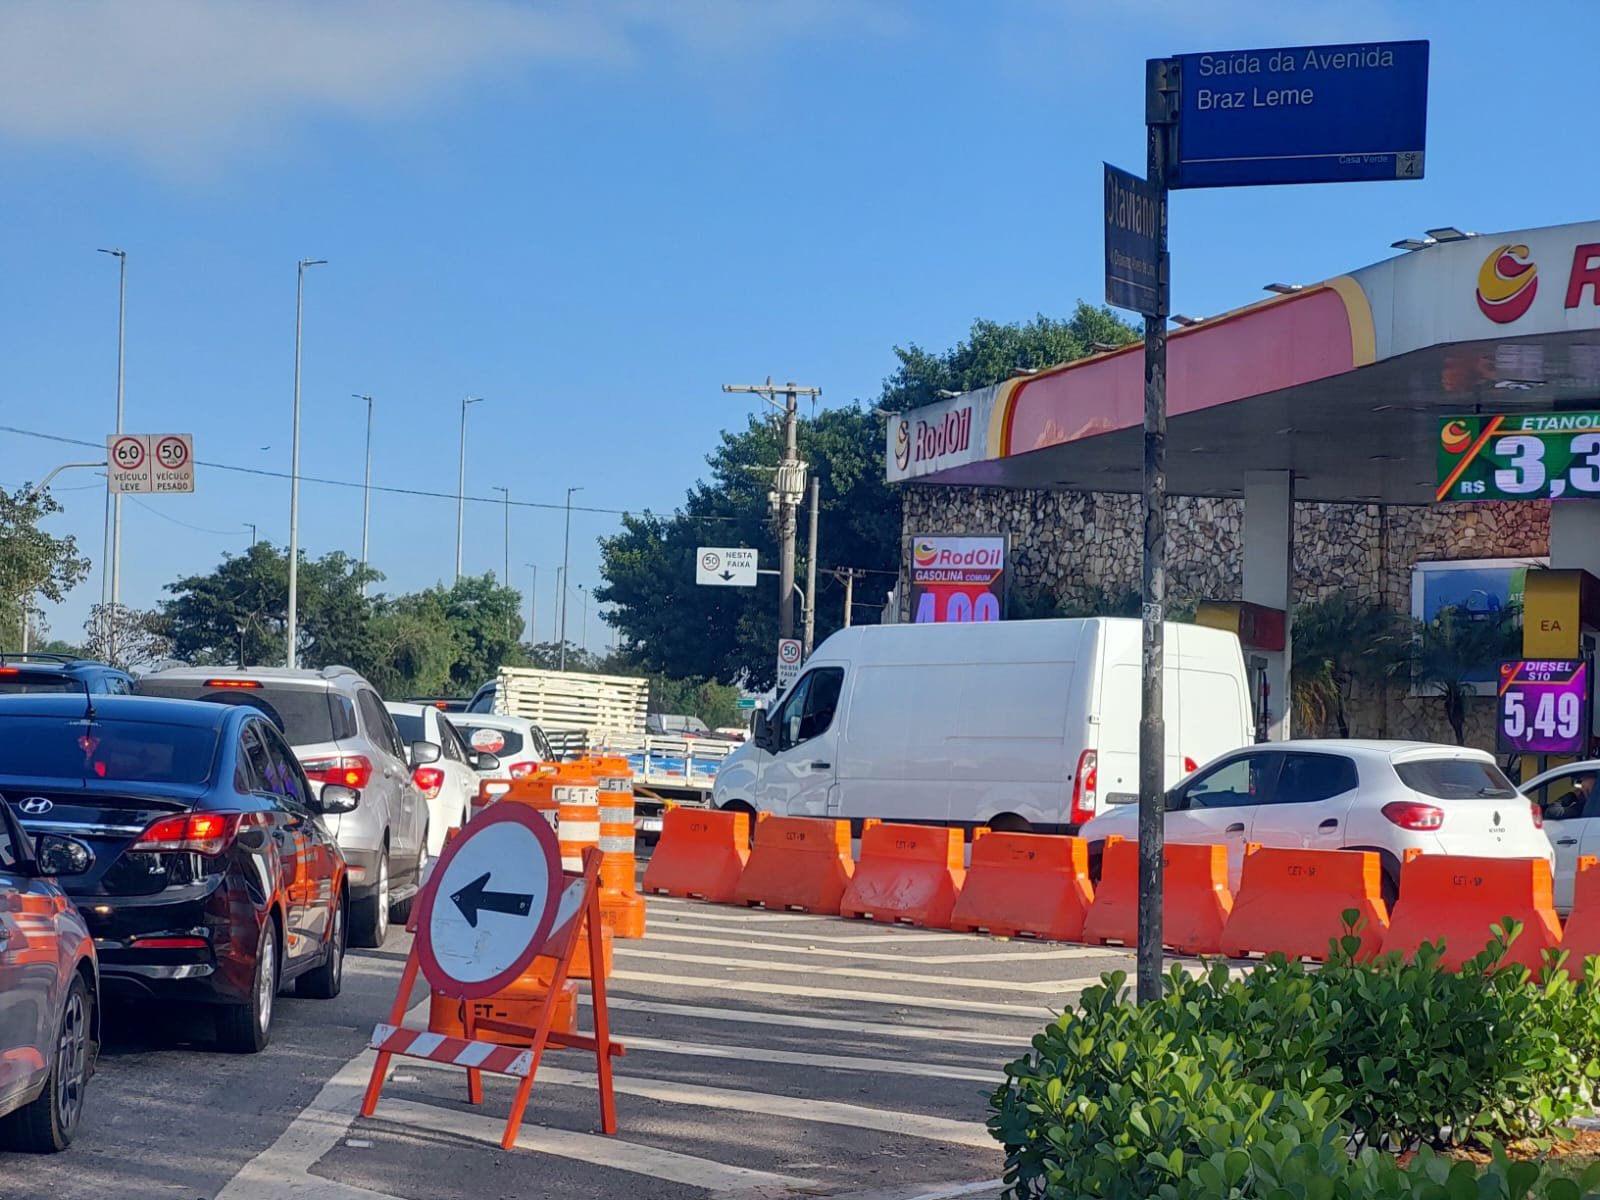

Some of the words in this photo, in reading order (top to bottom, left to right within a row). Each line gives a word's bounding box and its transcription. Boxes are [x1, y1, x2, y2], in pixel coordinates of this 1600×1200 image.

[1199, 53, 1261, 76] Saída
[1268, 51, 1295, 72] da
[1303, 47, 1394, 71] Avenida
[1197, 89, 1246, 110] Braz
[1253, 87, 1314, 107] Leme
[1338, 156, 1361, 164] Casa
[1363, 155, 1388, 163] Verde
[1405, 162, 1415, 175] 4
[1107, 172, 1155, 240] Otaviano
[915, 406, 972, 462] RodOil
[118, 445, 139, 460] 60
[162, 445, 183, 459] 50
[114, 472, 148, 481] VEÍCULO
[156, 472, 190, 481] VEÍCULO
[120, 483, 140, 491] LEVE
[1460, 480, 1486, 494] R$
[705, 556, 718, 565] 50
[939, 549, 1001, 565] RodOil
[915, 570, 963, 581] GASOLINA
[1541, 620, 1561, 632] EA
[784, 646, 797, 656] 50
[1525, 662, 1572, 672] DIESEL
[1528, 672, 1550, 681] S10
[1504, 692, 1579, 742] 5,49
